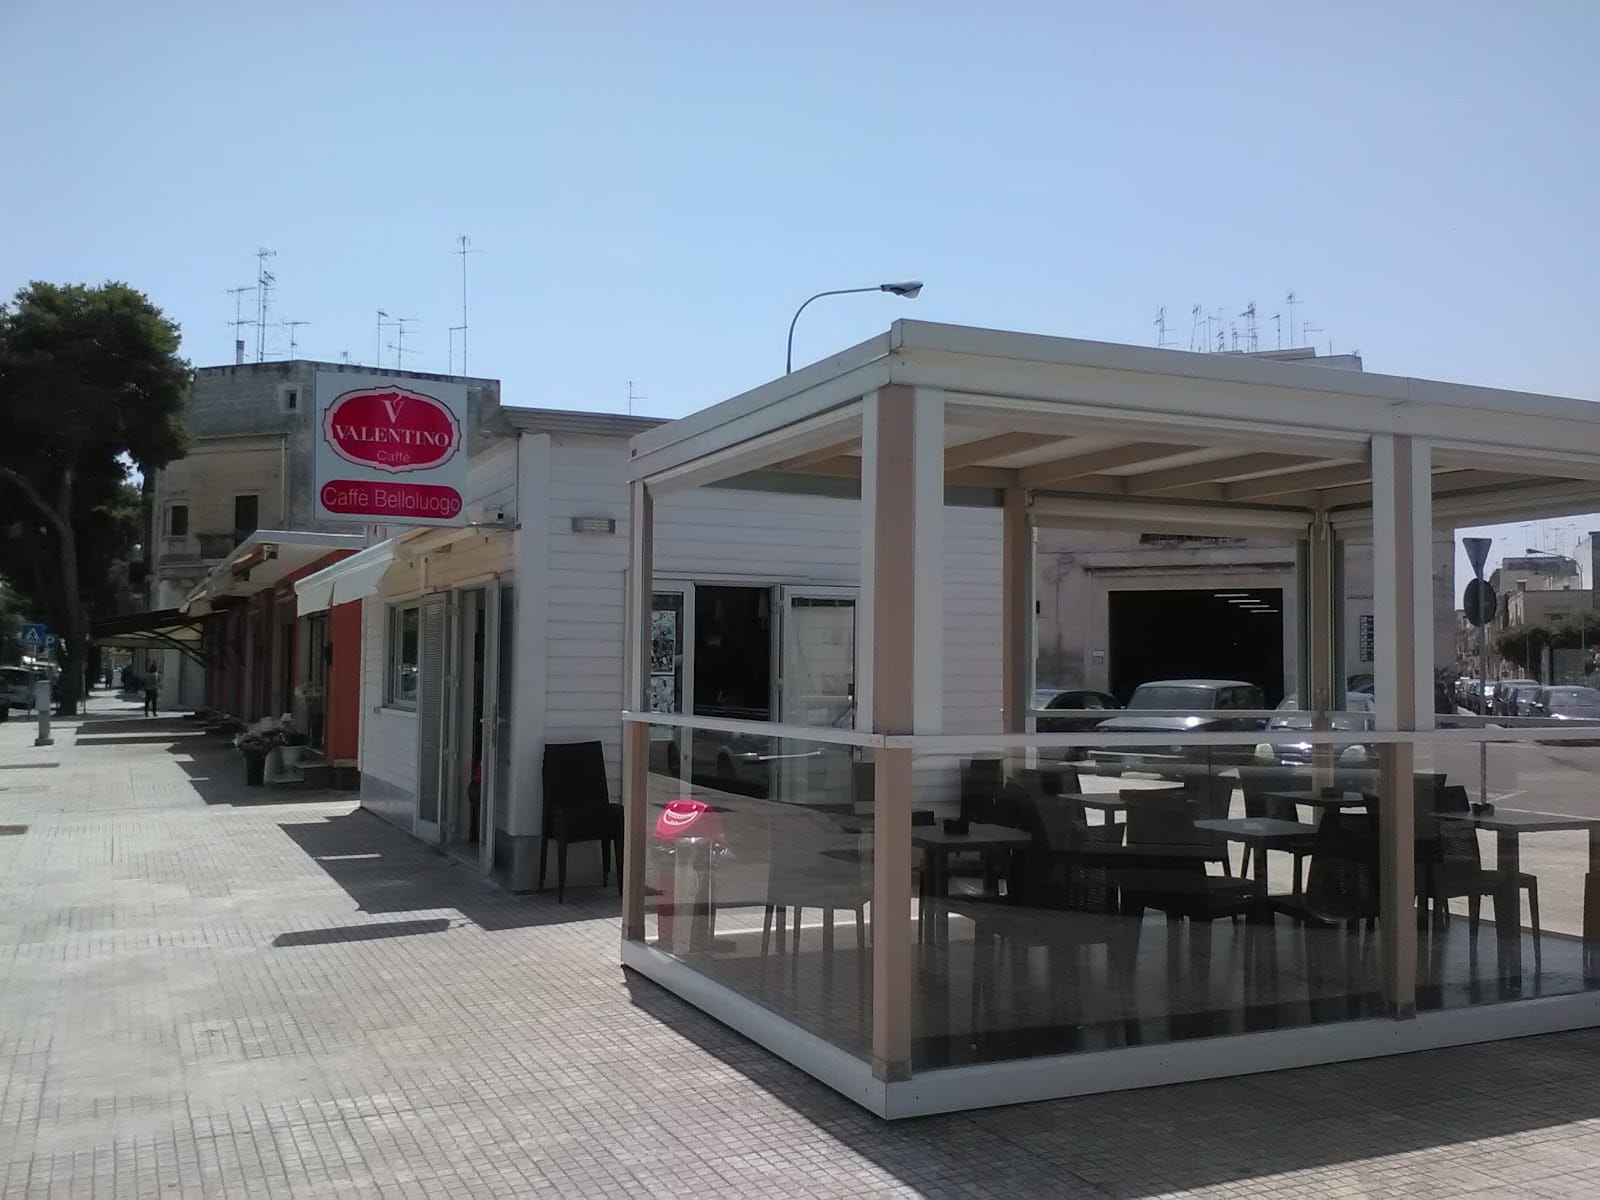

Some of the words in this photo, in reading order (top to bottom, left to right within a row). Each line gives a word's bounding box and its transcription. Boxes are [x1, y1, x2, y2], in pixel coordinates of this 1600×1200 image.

[383, 397, 405, 423] V
[335, 424, 450, 446] VALENTINO
[323, 487, 369, 506] Caffè
[375, 489, 461, 515] Belloluogo
[45, 634, 55, 647] P
